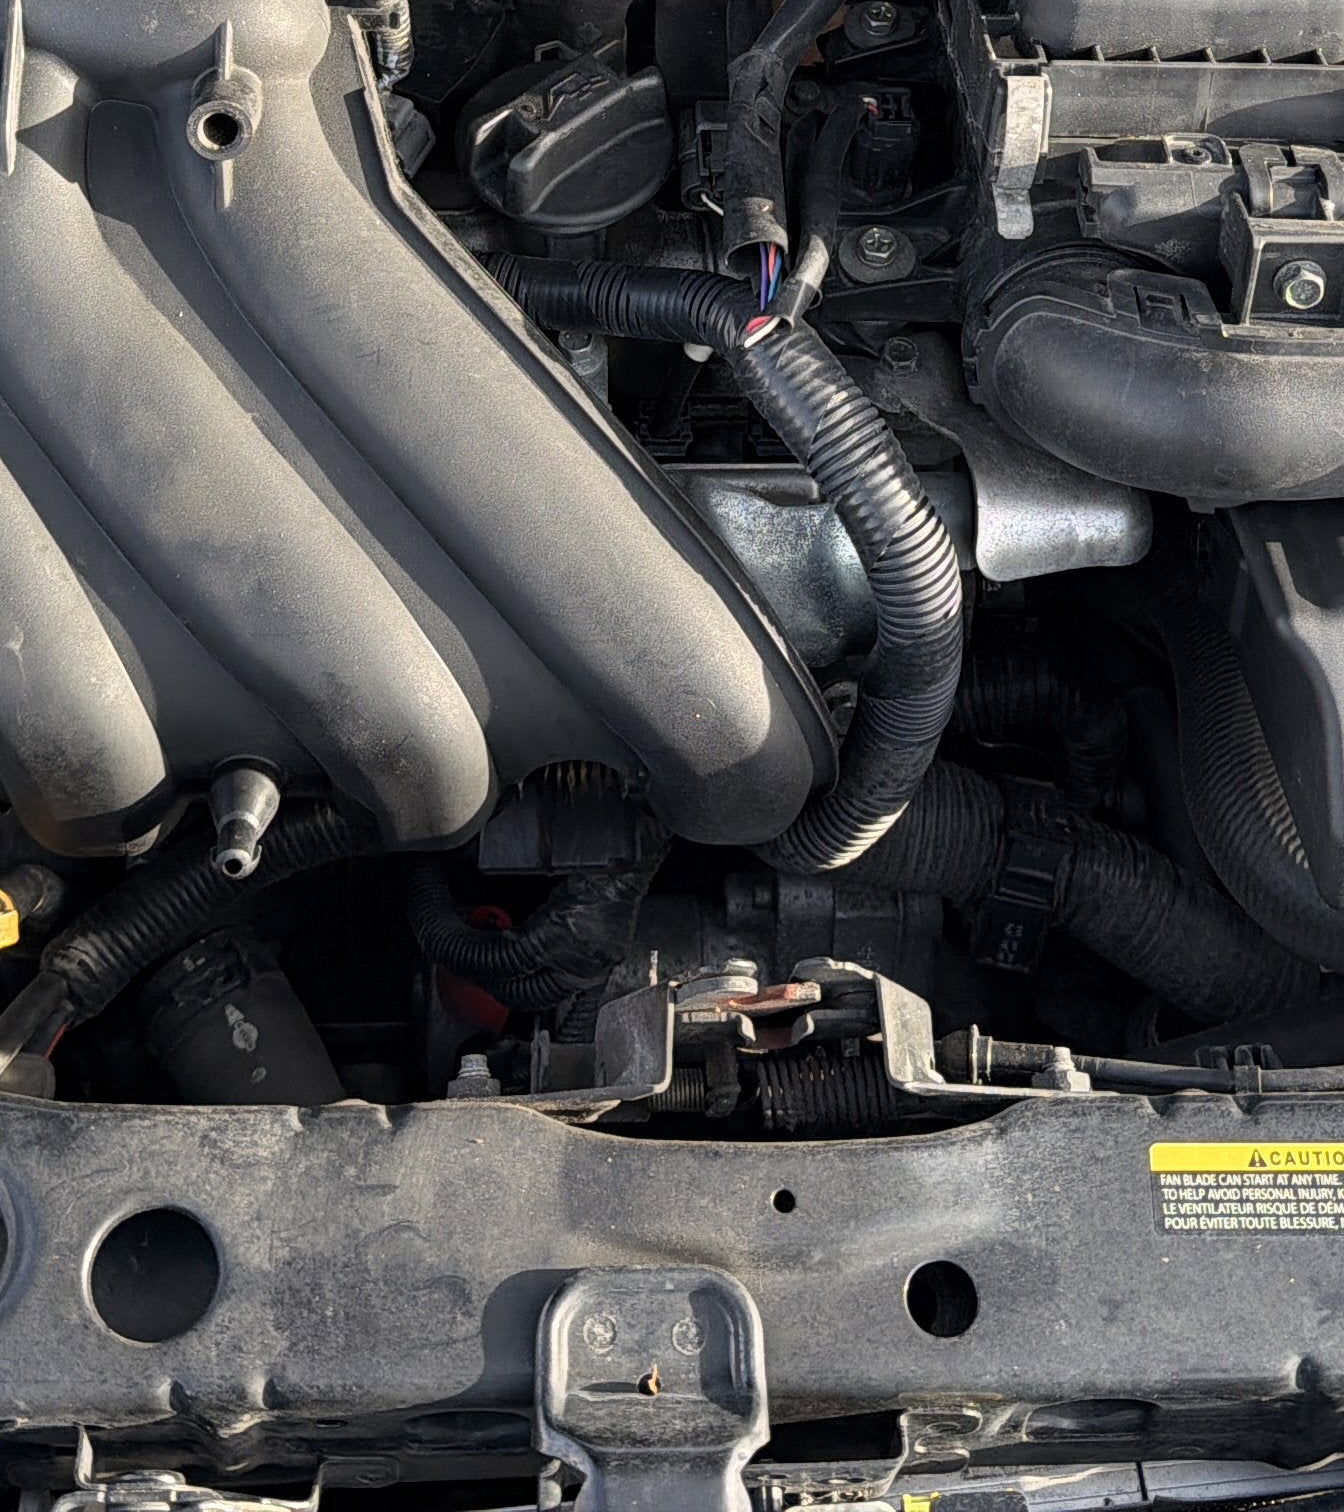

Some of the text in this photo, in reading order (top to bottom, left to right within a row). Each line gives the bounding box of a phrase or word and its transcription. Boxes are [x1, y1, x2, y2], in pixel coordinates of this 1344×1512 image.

[1160, 1174, 1343, 1186] FAN BLADE CAN START AT ANY TIME.
[1162, 1188, 1178, 1201] TO
[1180, 1188, 1206, 1201] HELP
[1208, 1188, 1241, 1201] AVOID
[1242, 1188, 1296, 1201] PERSONAL
[1298, 1188, 1336, 1201] INJURY,
[1163, 1202, 1177, 1214] LE
[1178, 1202, 1255, 1214] VENTILATEUR
[1256, 1202, 1298, 1214] RISQUE
[1300, 1202, 1316, 1214] DE
[1165, 1216, 1198, 1230] POUR
[1200, 1216, 1238, 1230] ÉVITER
[1240, 1216, 1278, 1230] TOUTE
[1280, 1216, 1339, 1230] BLESSURE,
